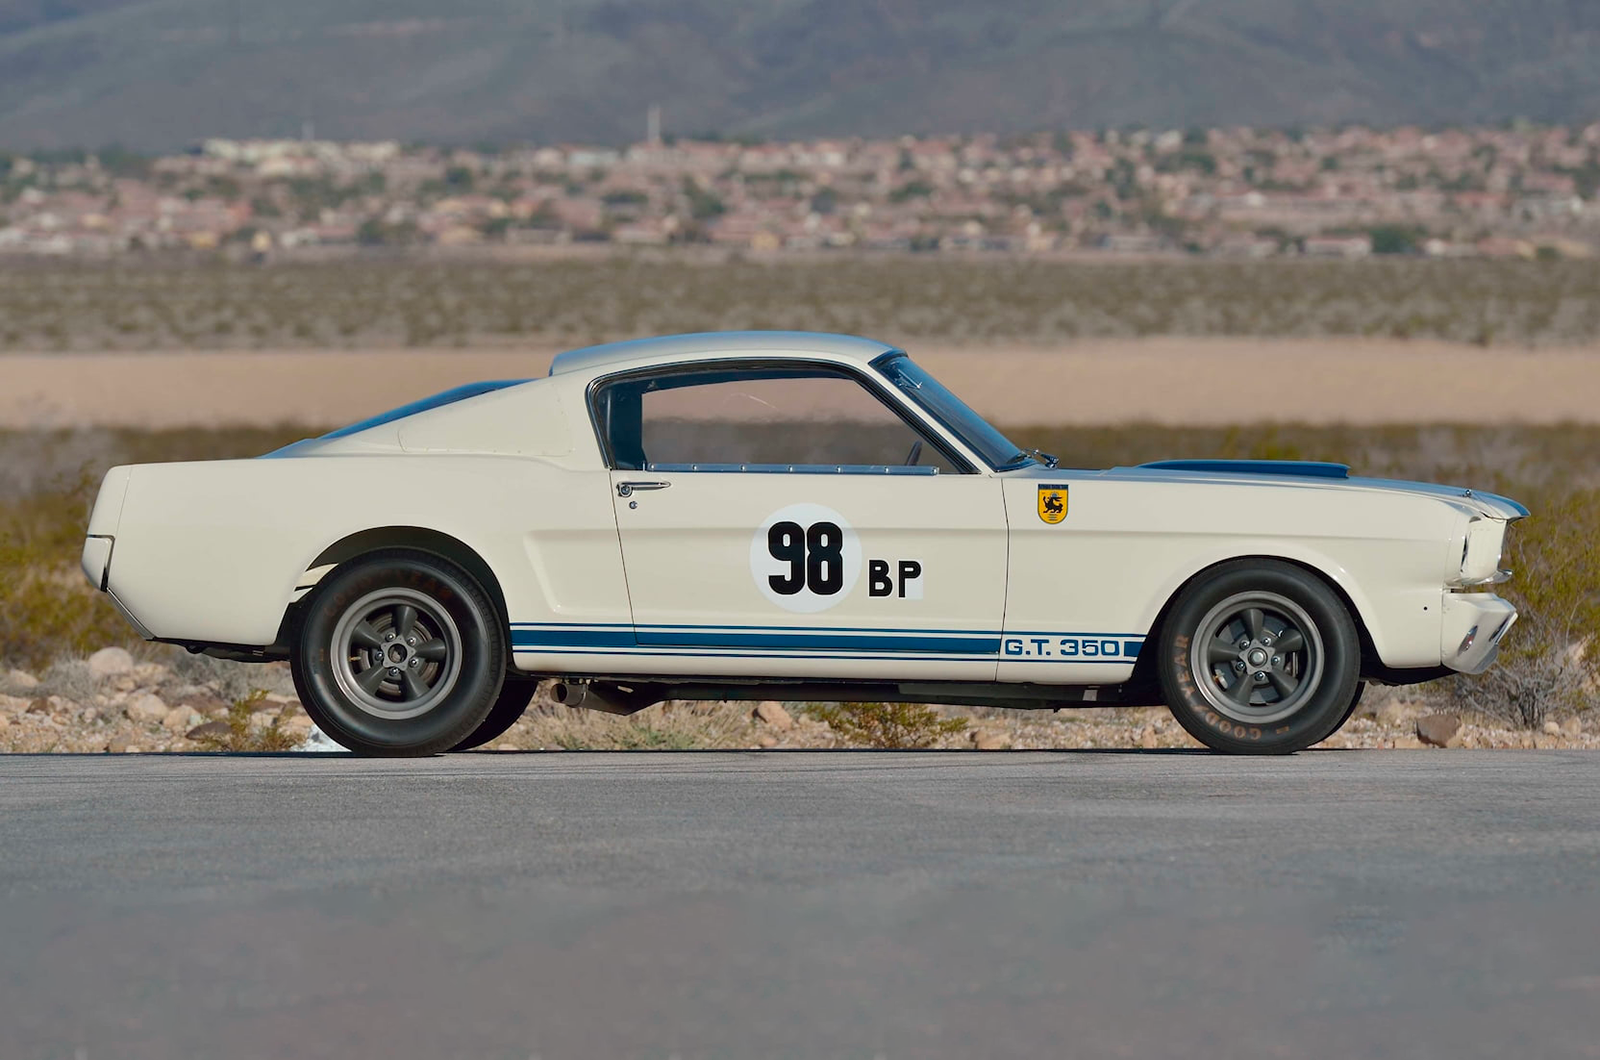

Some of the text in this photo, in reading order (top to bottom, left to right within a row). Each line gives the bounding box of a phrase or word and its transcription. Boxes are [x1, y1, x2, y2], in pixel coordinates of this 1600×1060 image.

[768, 521, 922, 598] 98 BP
[1005, 639, 1120, 656] G.T. 350
